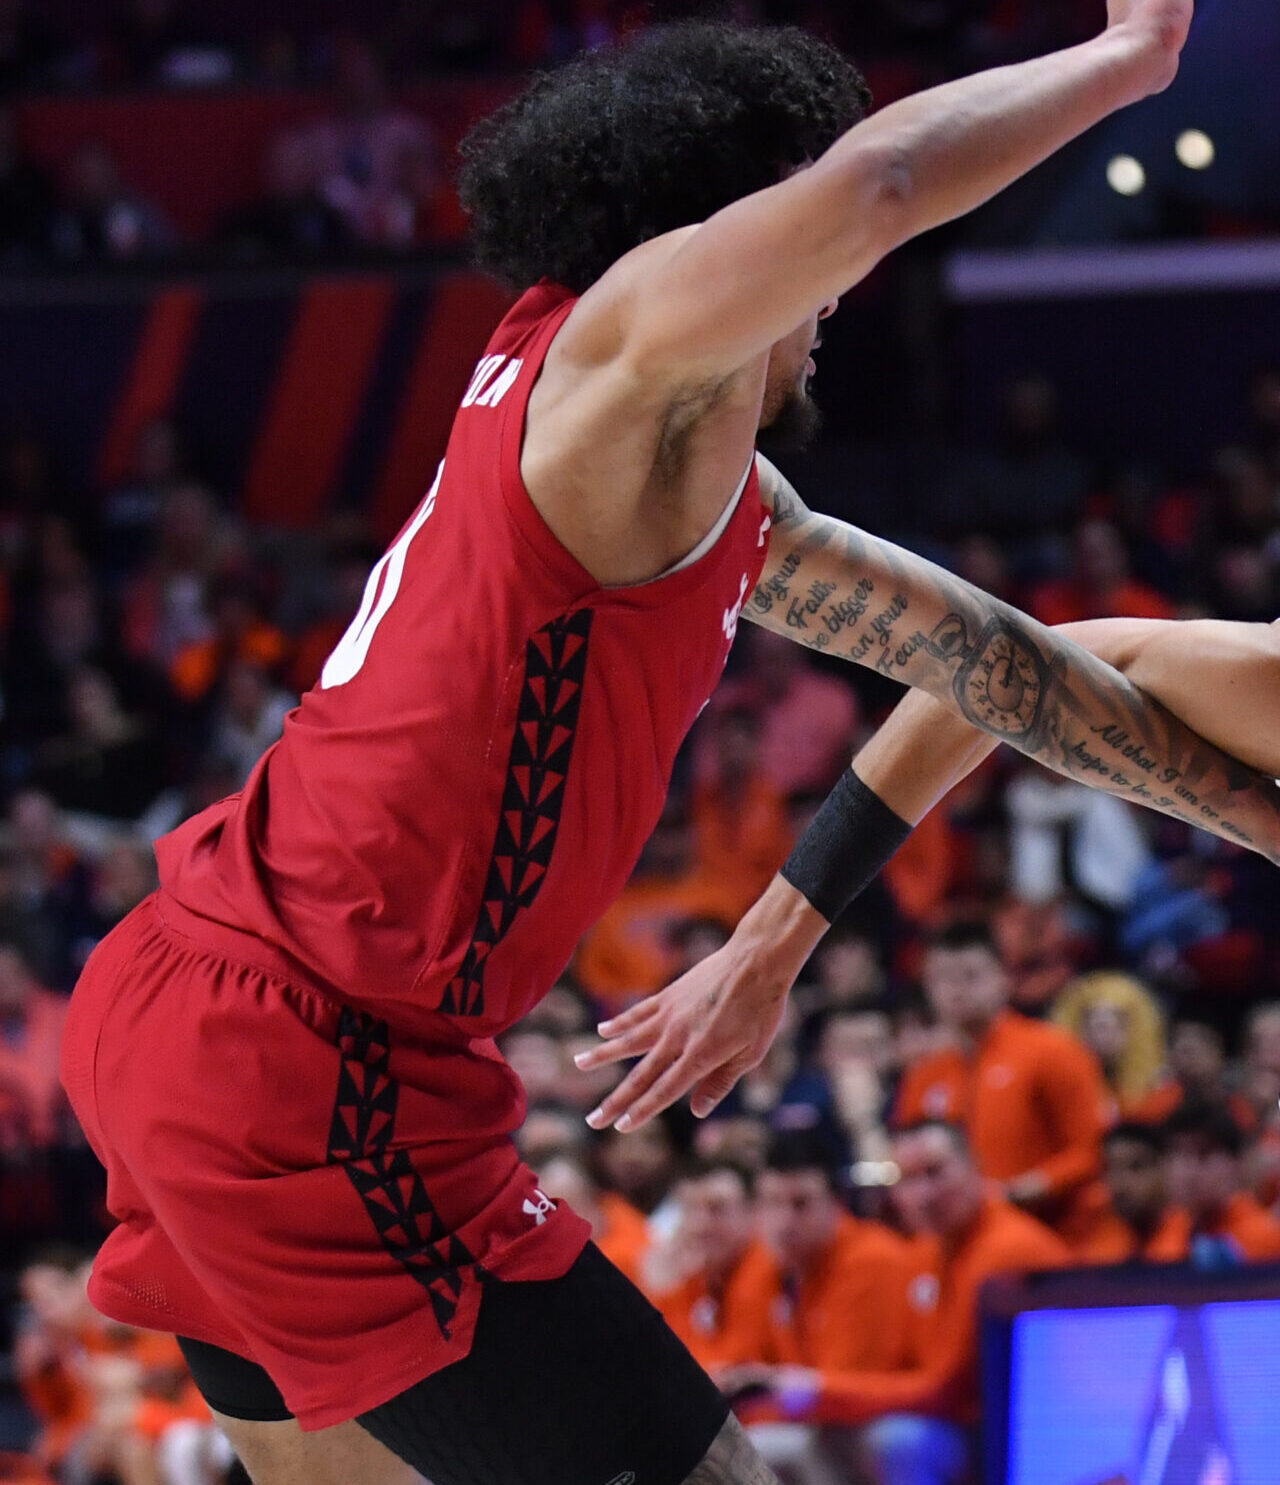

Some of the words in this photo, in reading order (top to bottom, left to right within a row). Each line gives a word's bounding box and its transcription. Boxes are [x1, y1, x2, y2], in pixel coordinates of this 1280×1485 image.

[460, 353, 525, 408] ON
[766, 552, 801, 602] your
[785, 580, 838, 630] Faith
[822, 577, 874, 634] bigger
[869, 593, 909, 647] your
[1071, 740, 1109, 776] hope
[1110, 771, 1132, 787] to
[1090, 724, 1129, 749] All
[1121, 743, 1157, 774] that
[1174, 785, 1199, 806] am
[1200, 804, 1220, 820] or
